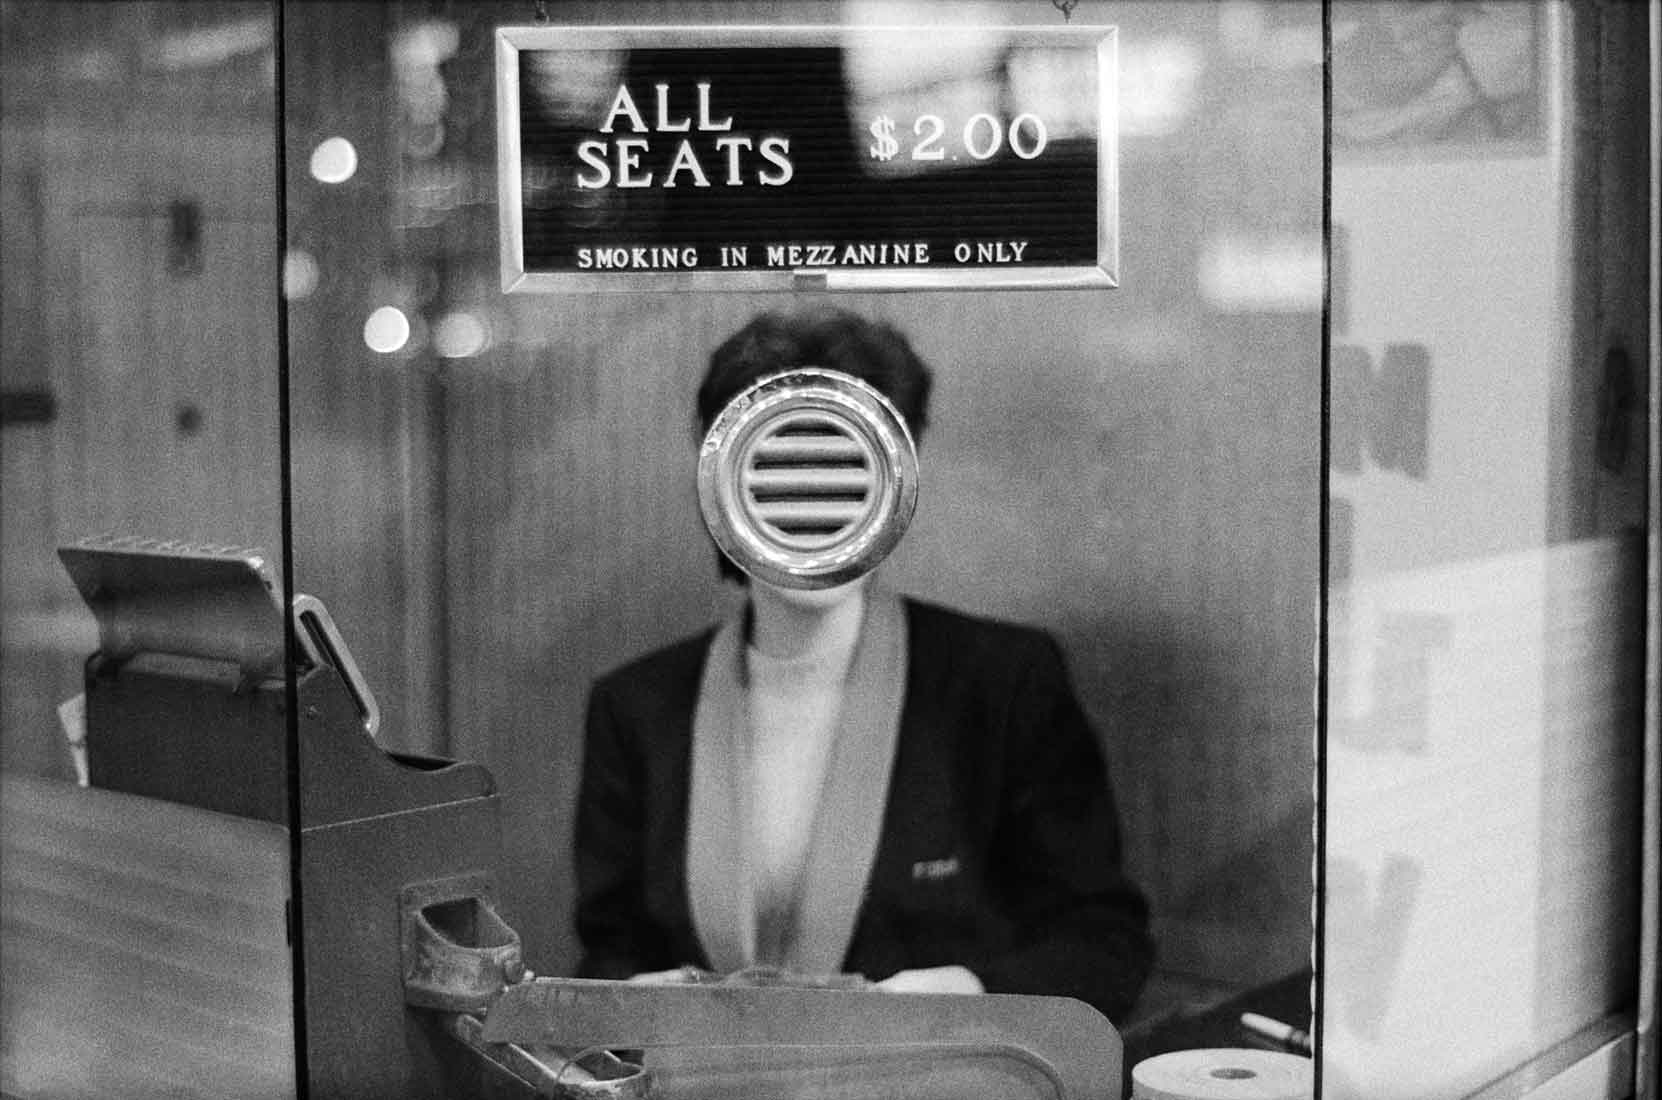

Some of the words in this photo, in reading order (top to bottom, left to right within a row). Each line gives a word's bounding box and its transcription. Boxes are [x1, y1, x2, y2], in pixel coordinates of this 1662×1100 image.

[600, 82, 733, 132] ALL
[869, 113, 1048, 161] $2.00
[576, 137, 794, 188] SEATS
[577, 247, 698, 268] SMOKING
[720, 246, 748, 267] IN
[766, 244, 930, 266] MEZZANINE
[954, 241, 1028, 263] ONLY
